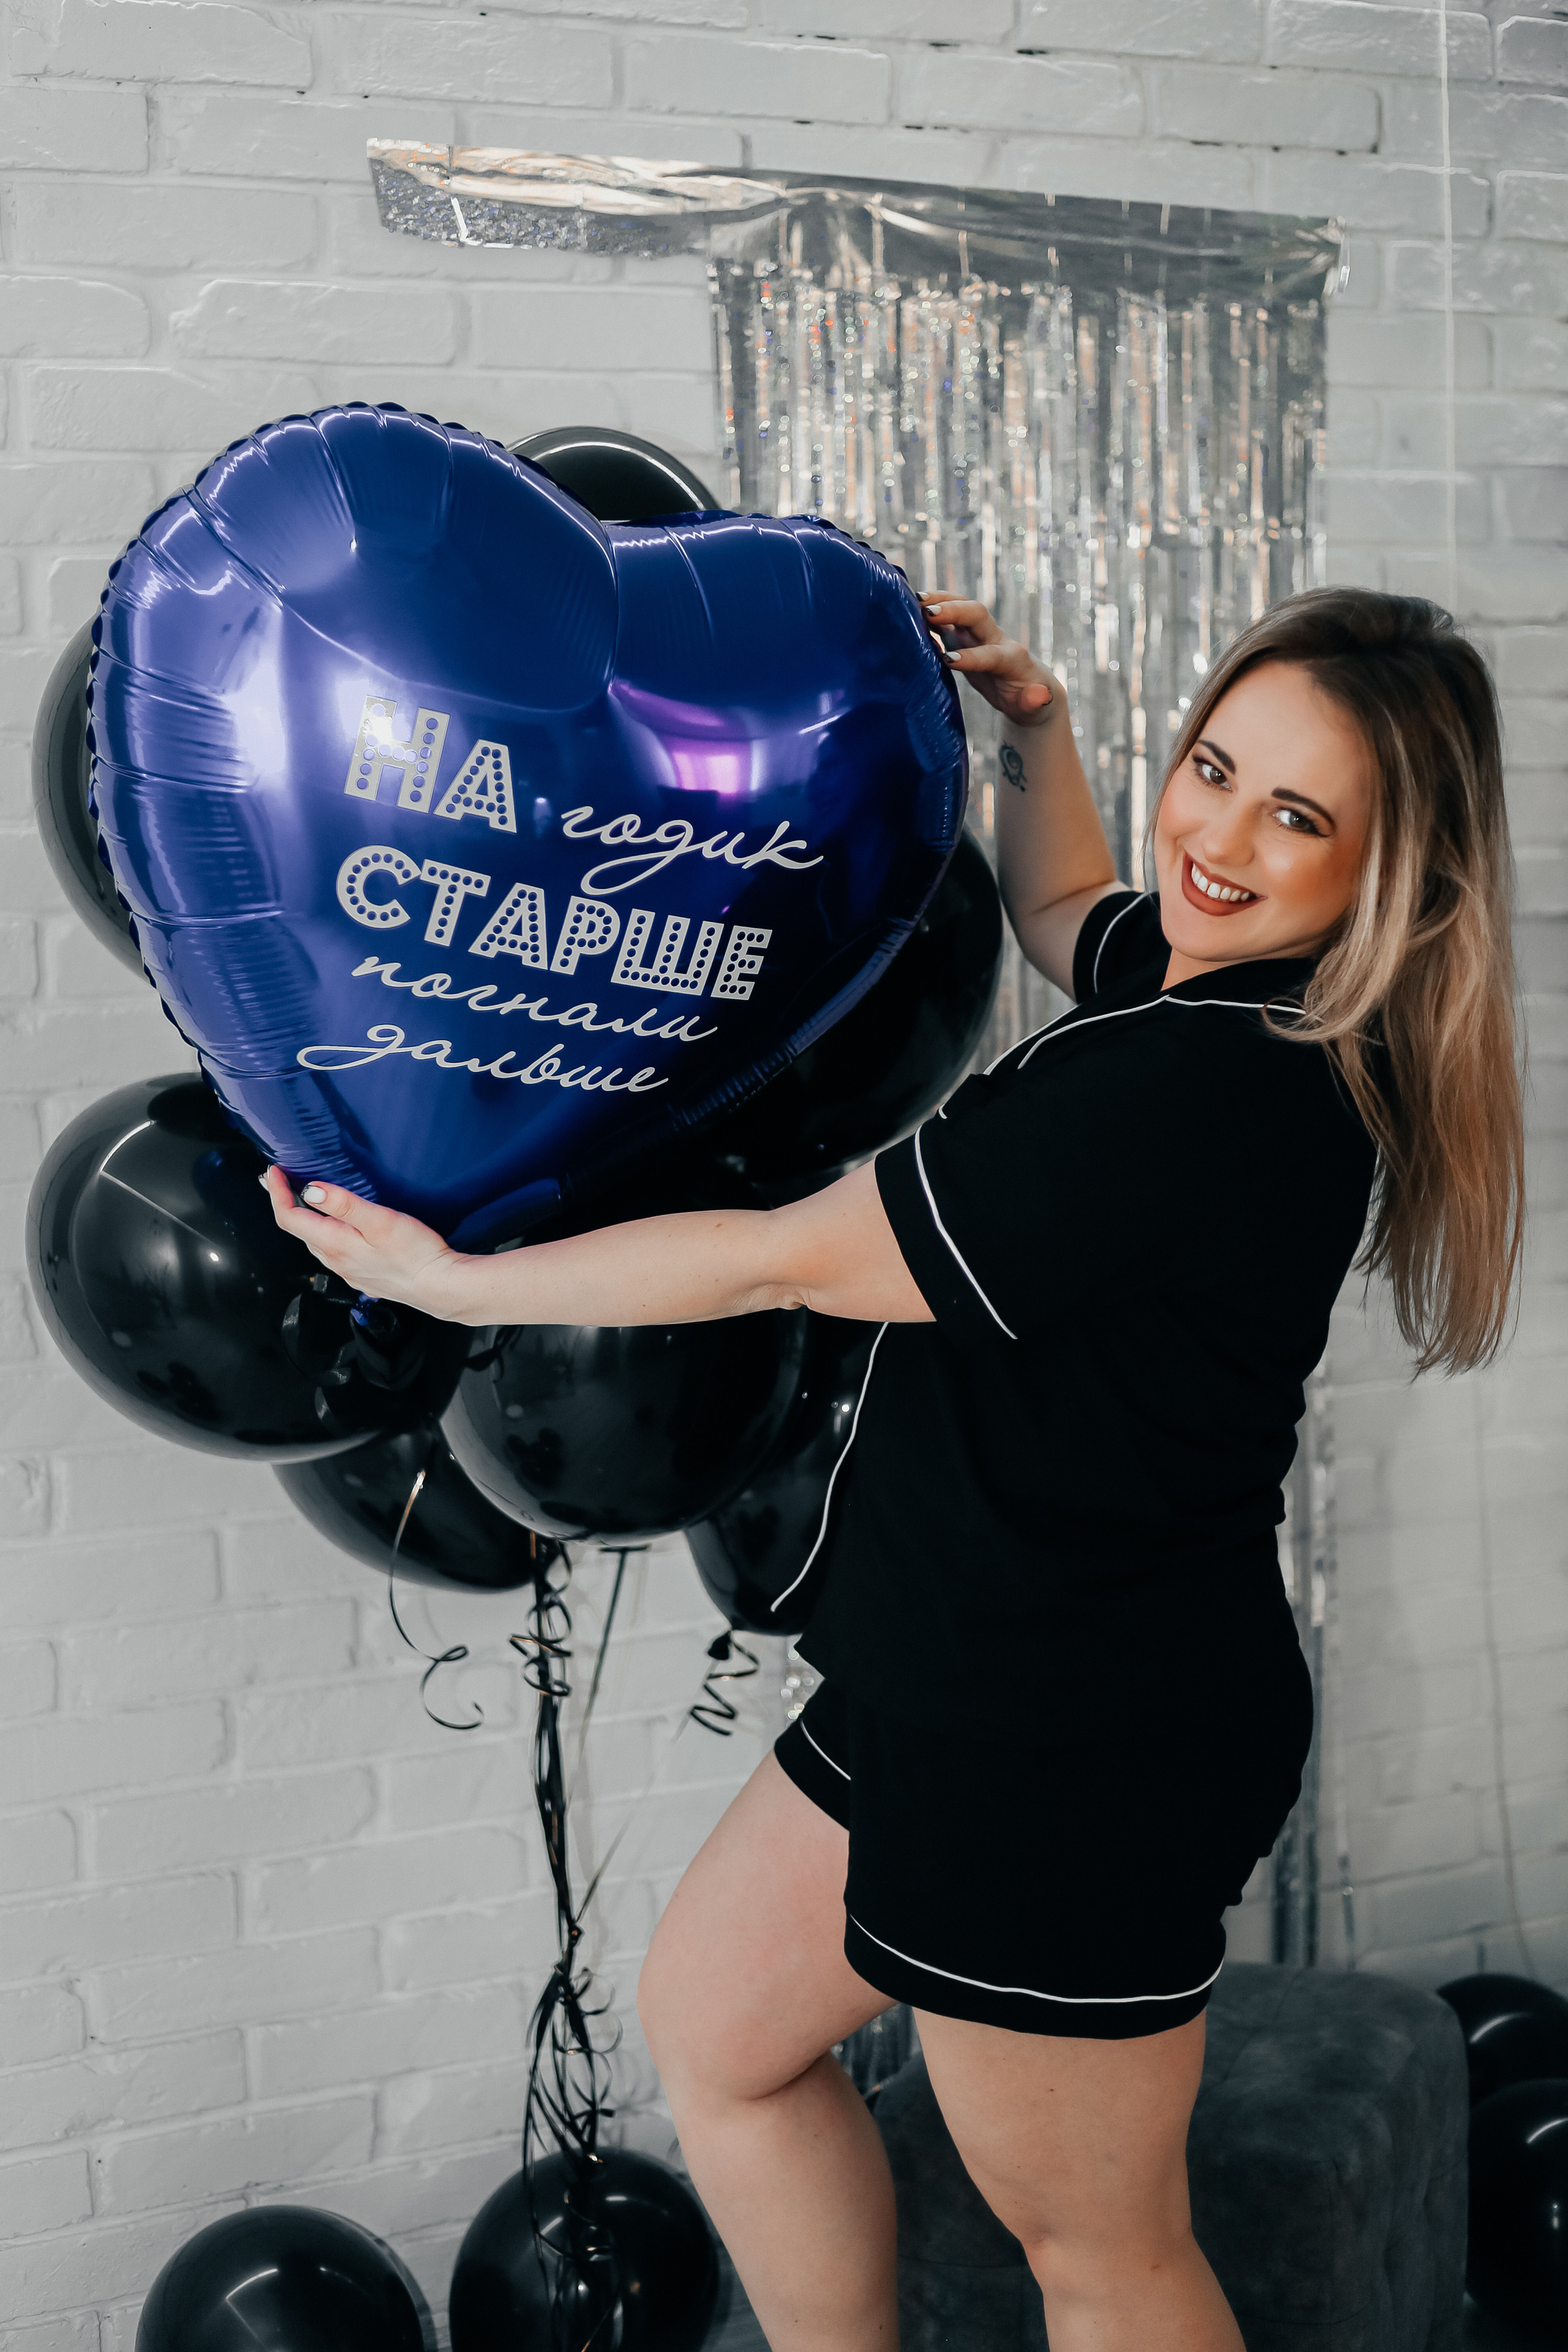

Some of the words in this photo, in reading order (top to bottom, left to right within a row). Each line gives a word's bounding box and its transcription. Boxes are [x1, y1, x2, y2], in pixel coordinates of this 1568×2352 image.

[344, 695, 516, 833] НА
[561, 806, 824, 895] годик
[336, 845, 772, 1000] СТАРШЕ
[296, 1024, 668, 1091] дальше
[352, 956, 718, 1041] погнали
